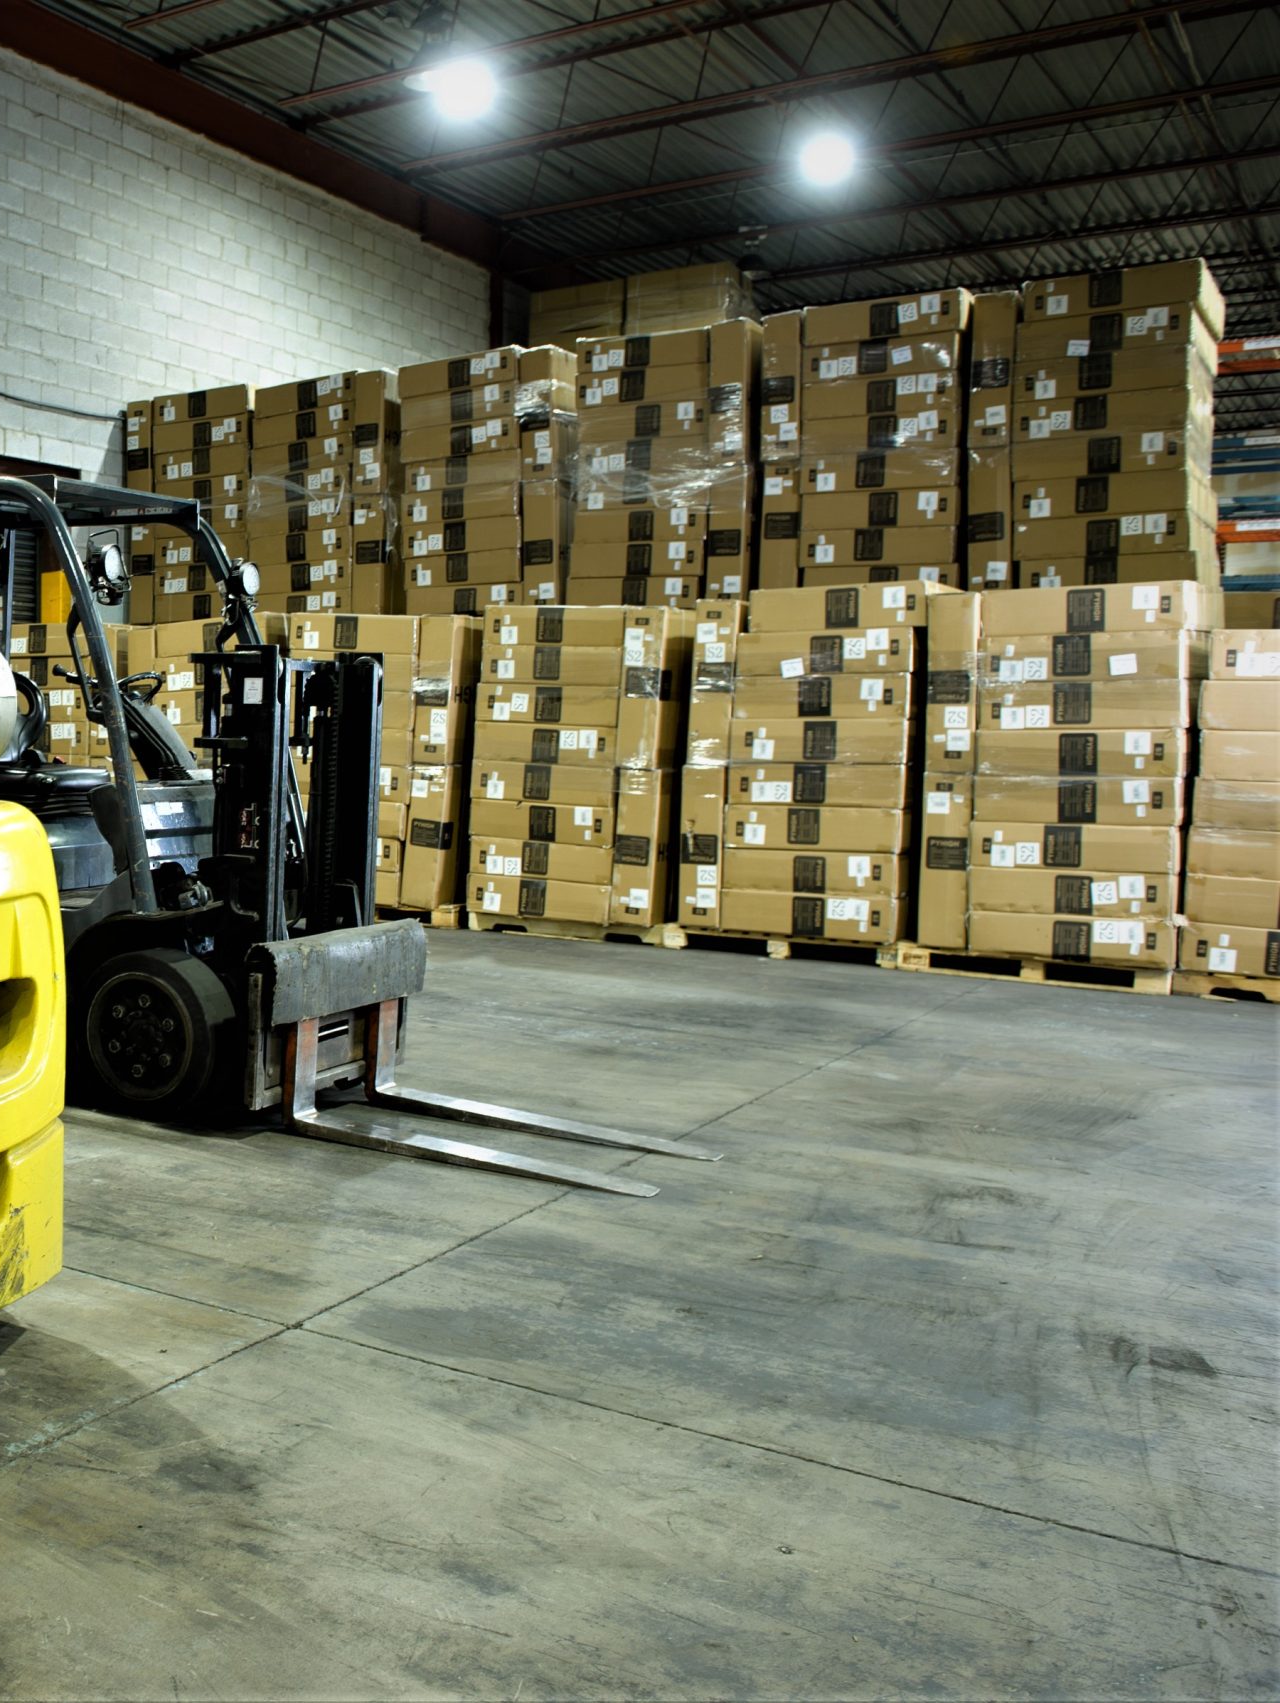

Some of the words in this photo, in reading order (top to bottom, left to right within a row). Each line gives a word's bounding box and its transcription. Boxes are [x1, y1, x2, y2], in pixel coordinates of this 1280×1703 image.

[902, 304, 914, 320] S2
[1130, 318, 1144, 333] S2
[841, 359, 853, 374] S2
[901, 376, 913, 392] S2
[1054, 413, 1067, 429] S2
[1125, 517, 1139, 533] S2
[626, 650, 642, 662] S2
[706, 646, 723, 658] S2
[848, 640, 862, 656] S2
[1028, 660, 1043, 678] S2
[514, 695, 526, 710] S2
[432, 712, 446, 724] S2
[947, 711, 966, 724] S2
[1030, 708, 1045, 726] S2
[563, 732, 575, 747] S2
[775, 784, 788, 800] S2
[1020, 845, 1035, 863] S2
[507, 859, 518, 875] S2
[700, 870, 715, 882] S2
[1097, 884, 1113, 901] S2
[831, 900, 845, 917] S2
[1099, 922, 1114, 940] S2
